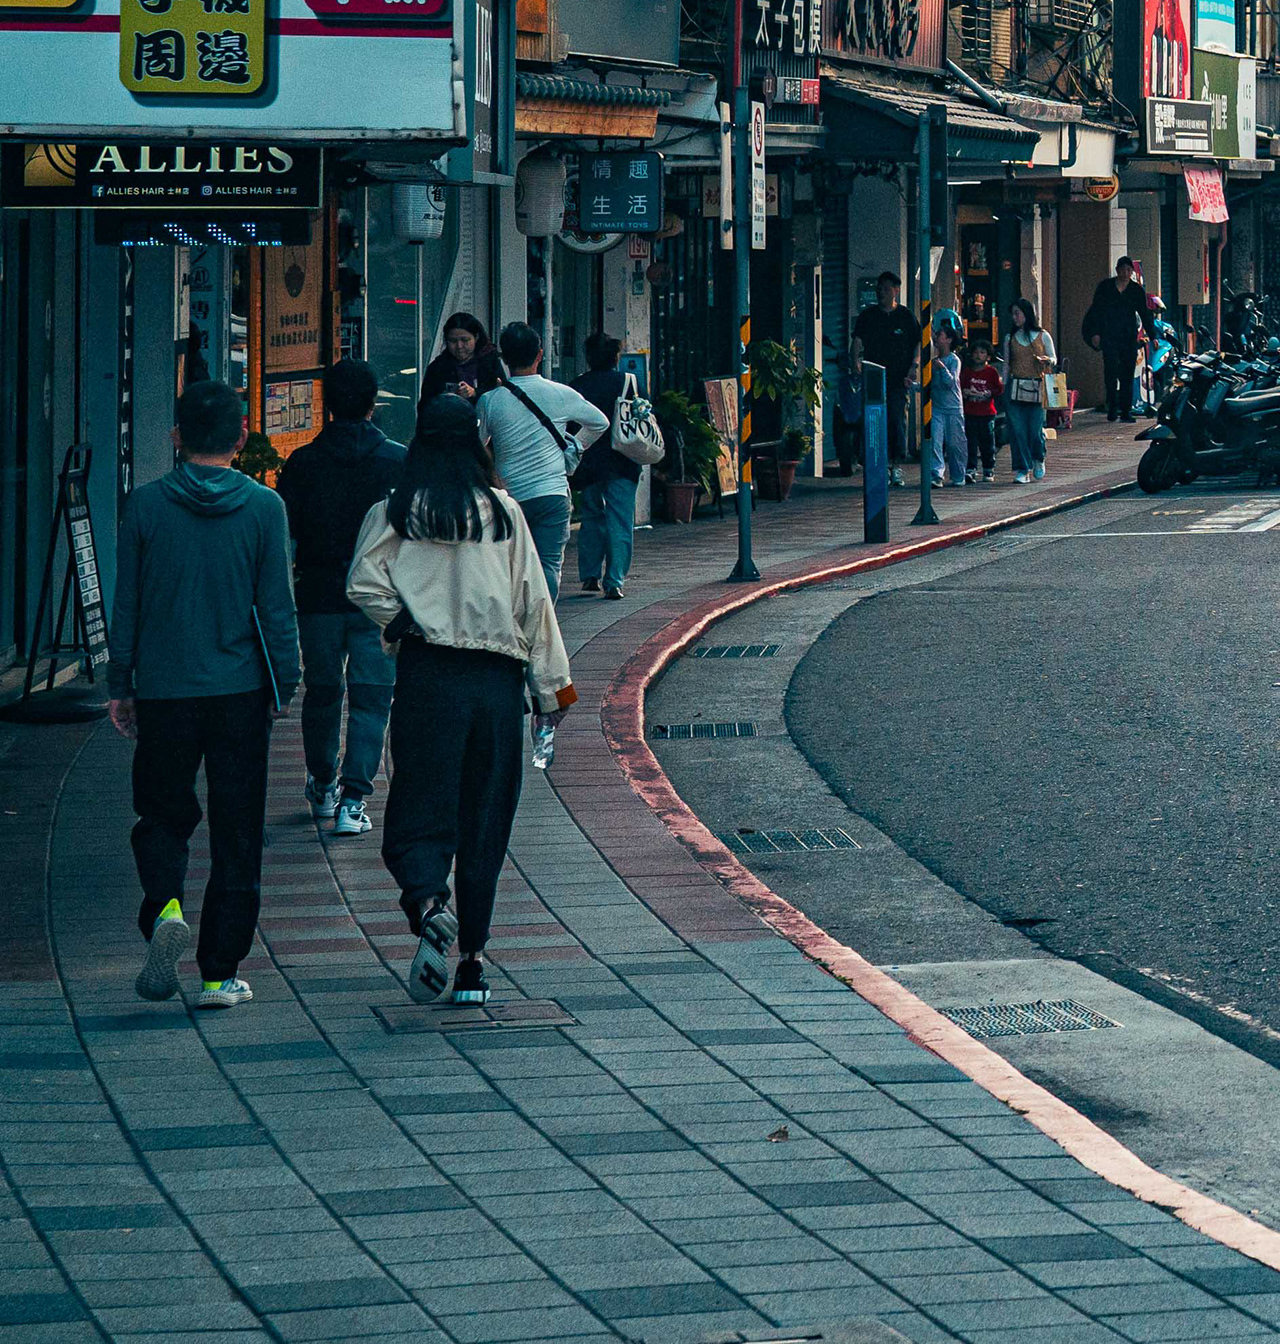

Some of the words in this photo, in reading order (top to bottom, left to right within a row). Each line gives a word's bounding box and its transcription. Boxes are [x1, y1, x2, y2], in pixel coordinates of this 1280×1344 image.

[132, 30, 252, 86] 周邊
[89, 145, 295, 174] ALLIES
[592, 159, 649, 179] 情趣
[107, 187, 140, 196] ALLIES
[141, 187, 165, 196] HAIR
[215, 187, 248, 196] ALLIES
[249, 187, 273, 196] HAIR
[592, 195, 648, 216] 生活
